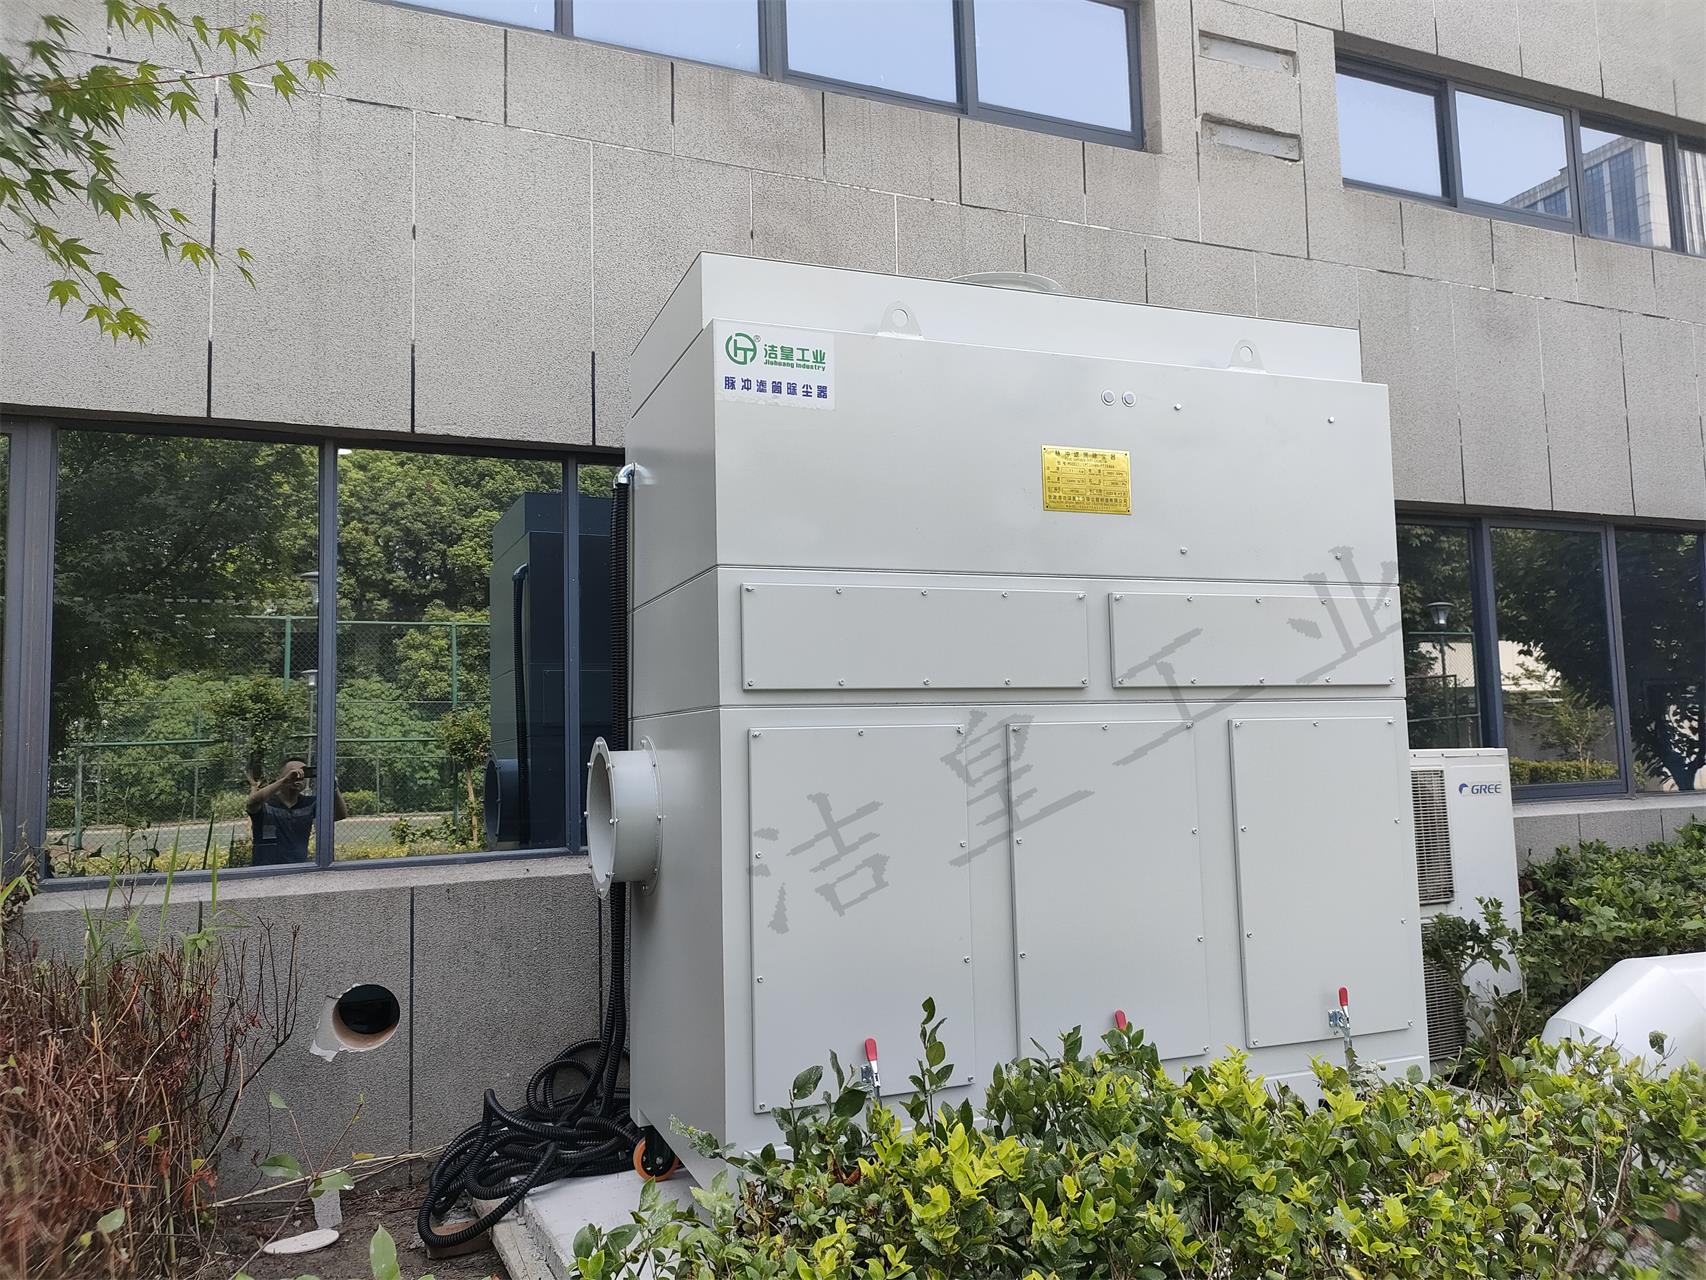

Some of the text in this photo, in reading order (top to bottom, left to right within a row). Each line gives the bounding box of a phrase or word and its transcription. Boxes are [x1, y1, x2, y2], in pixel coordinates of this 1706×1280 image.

[763, 344, 826, 364] 洁皇工业
[1471, 784, 1502, 795] GREE
